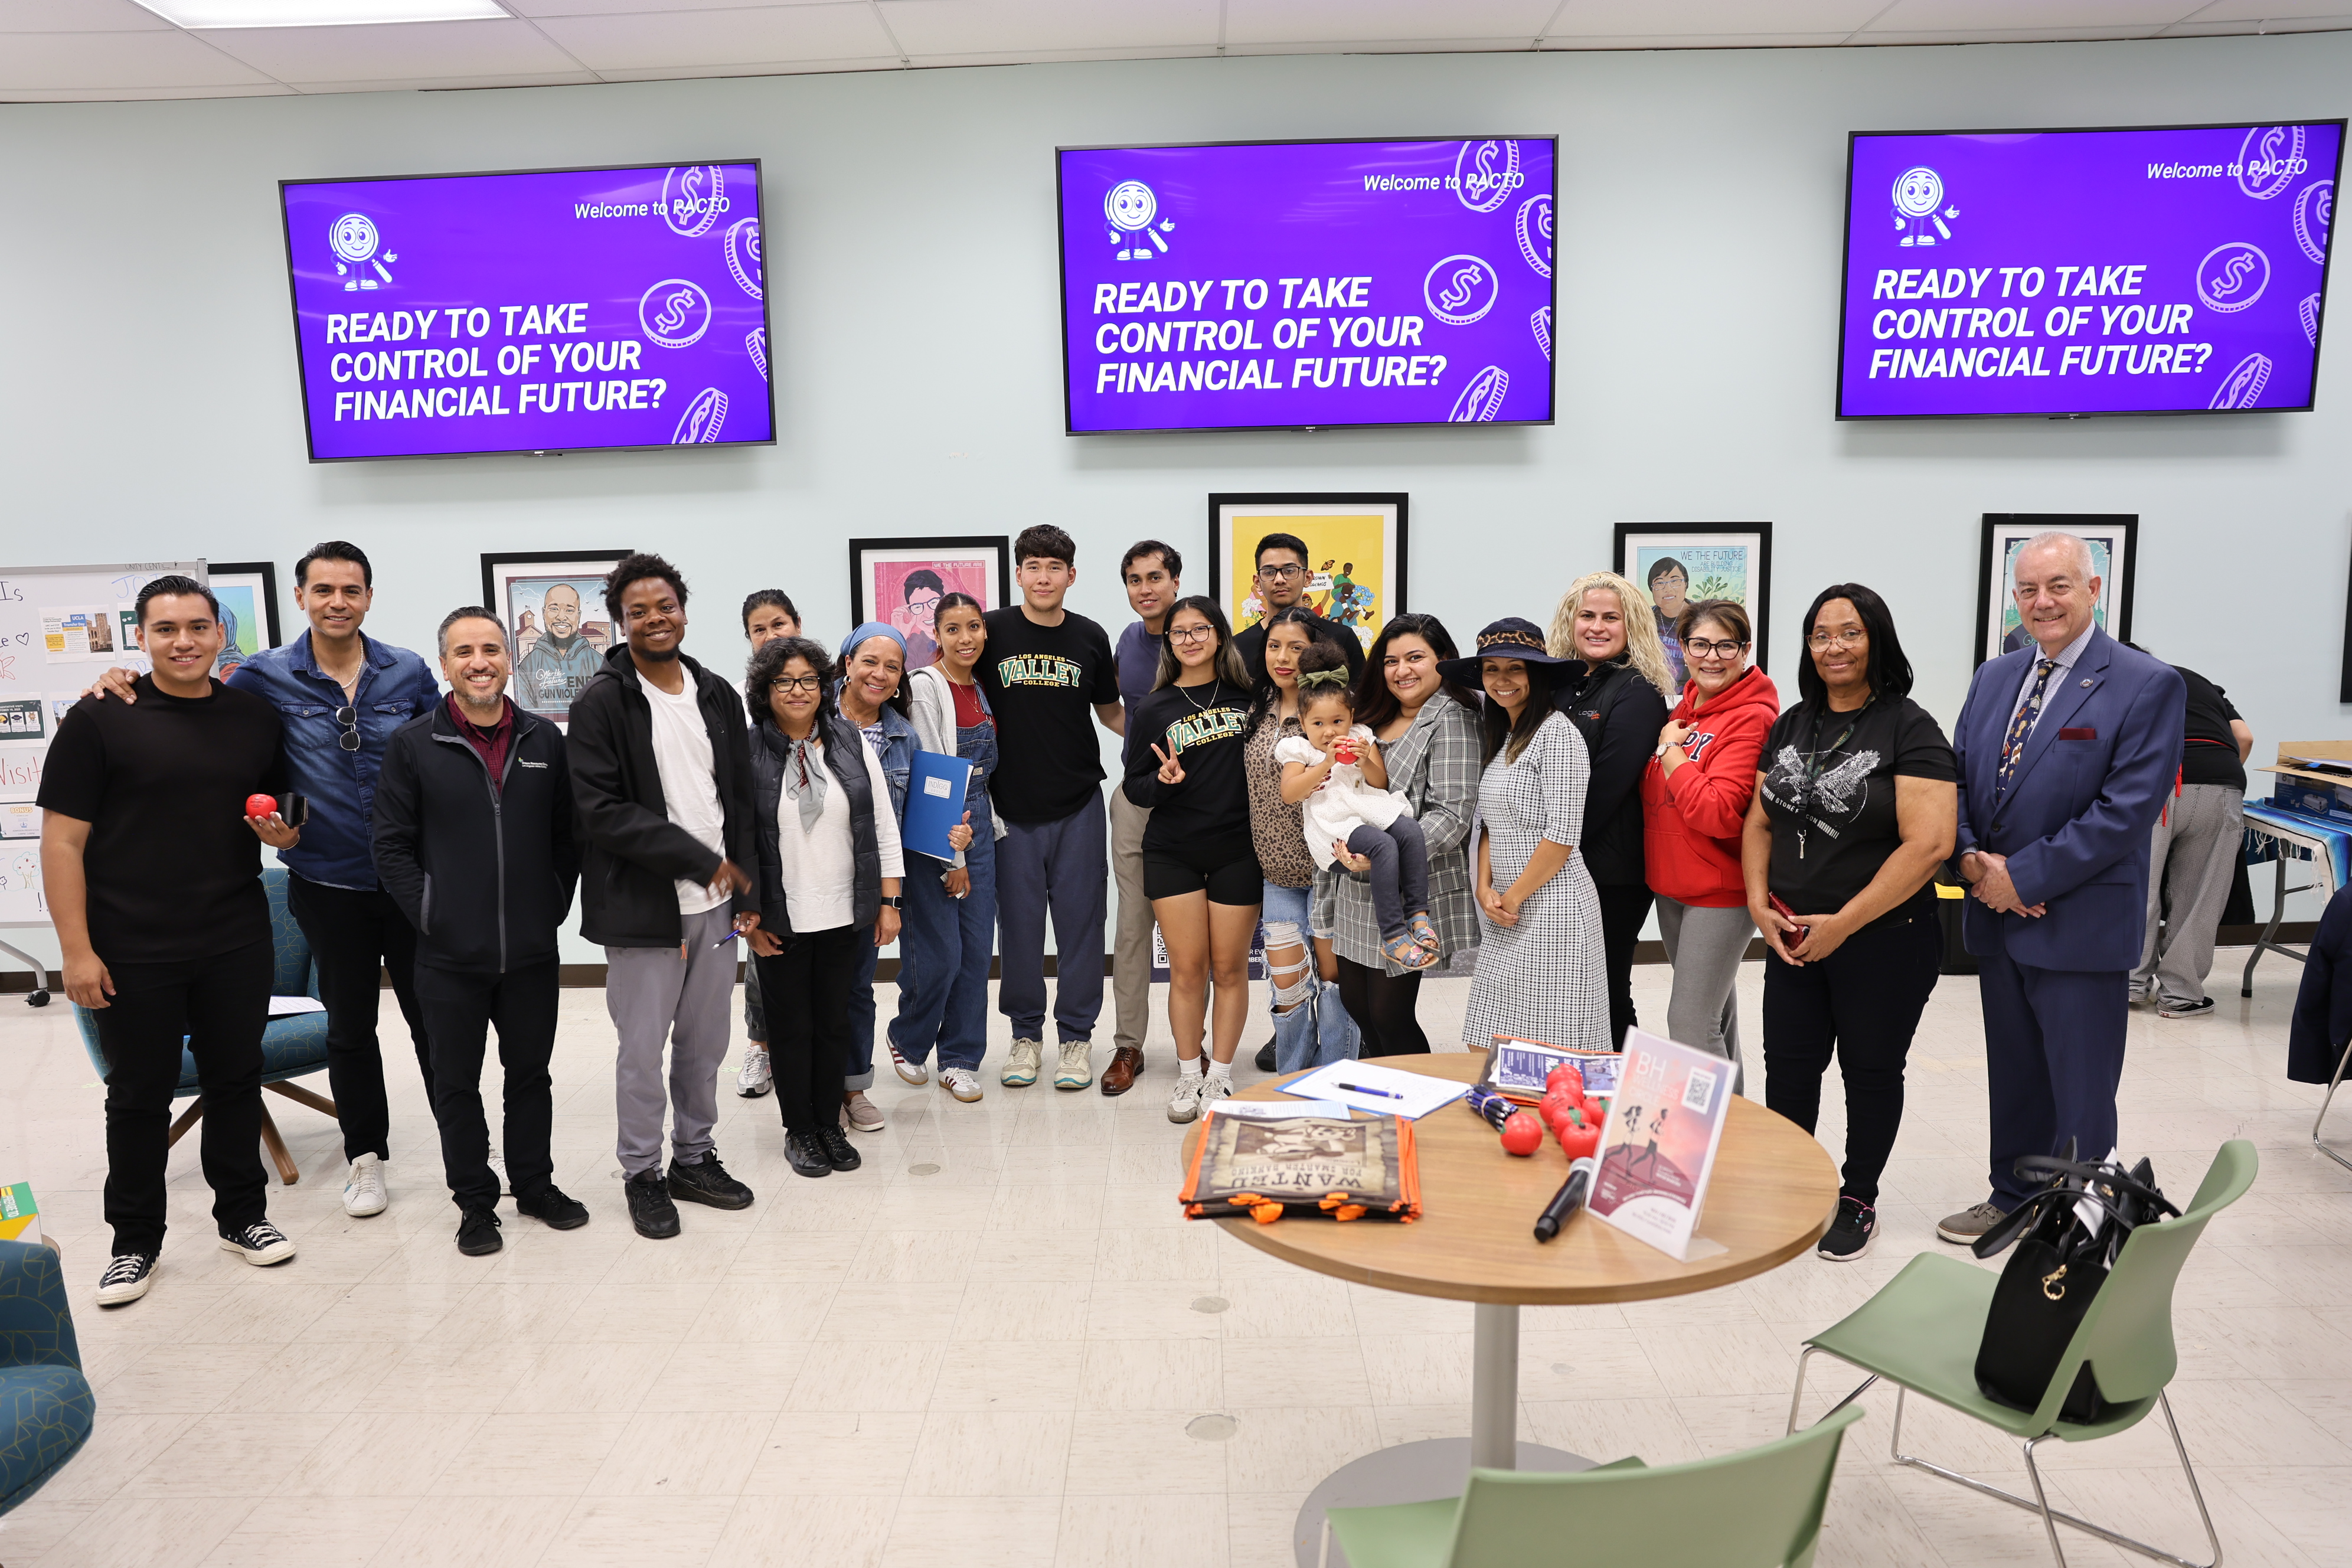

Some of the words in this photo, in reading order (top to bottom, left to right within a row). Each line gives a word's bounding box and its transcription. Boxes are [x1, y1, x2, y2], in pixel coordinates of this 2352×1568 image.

[1364, 174, 1440, 191] Welcome
[1445, 175, 1461, 189] to
[1465, 172, 1524, 189] PACTO
[2147, 162, 2223, 179] Welcome
[2227, 162, 2243, 177] to
[2247, 158, 2308, 176] PACTO
[574, 202, 648, 219] Welcome
[652, 201, 668, 215] to
[673, 197, 730, 214] PACTO
[1093, 280, 1214, 314] READY
[1221, 279, 1269, 311] TO
[1279, 276, 1373, 309] TAKE
[1873, 267, 1993, 300] READY
[2000, 266, 2045, 298] TO
[2056, 264, 2147, 296] TAKE
[326, 309, 438, 344] READY
[445, 307, 491, 338] TO
[499, 302, 589, 336] TAKE
[1096, 319, 1263, 354] CONTROL
[1272, 318, 1321, 349] OF
[1329, 316, 1424, 348] YOUR
[1872, 307, 2035, 339] CONTROL
[2045, 306, 2093, 337] OF
[2101, 303, 2193, 335] YOUR
[331, 347, 488, 383] CONTROL
[497, 344, 542, 375] OF
[550, 340, 642, 373] YOUR
[1096, 359, 1283, 394] FINANCIAL
[1291, 355, 1447, 388] FUTURE?
[1868, 347, 2051, 379] FINANCIAL
[2059, 342, 2213, 375] FUTURE?
[335, 385, 510, 422] FINANCIAL
[518, 378, 667, 414] FUTURE?
[144, 562, 161, 570] CENT
[1681, 551, 1693, 560] WE
[1696, 551, 1710, 560] THE
[1713, 550, 1743, 560] FUTURE
[998, 658, 1082, 688] VALLEY
[1034, 654, 1066, 662] ANGELES
[538, 689, 556, 698] GUN
[557, 688, 582, 698] VIOLE
[1182, 714, 1197, 723] LOS
[1198, 707, 1231, 718] ANGELES
[1195, 731, 1234, 746] COLLEGE
[1681, 731, 1715, 762] PY
[1775, 797, 1795, 812] STONE
[1636, 1051, 1667, 1082] BH
